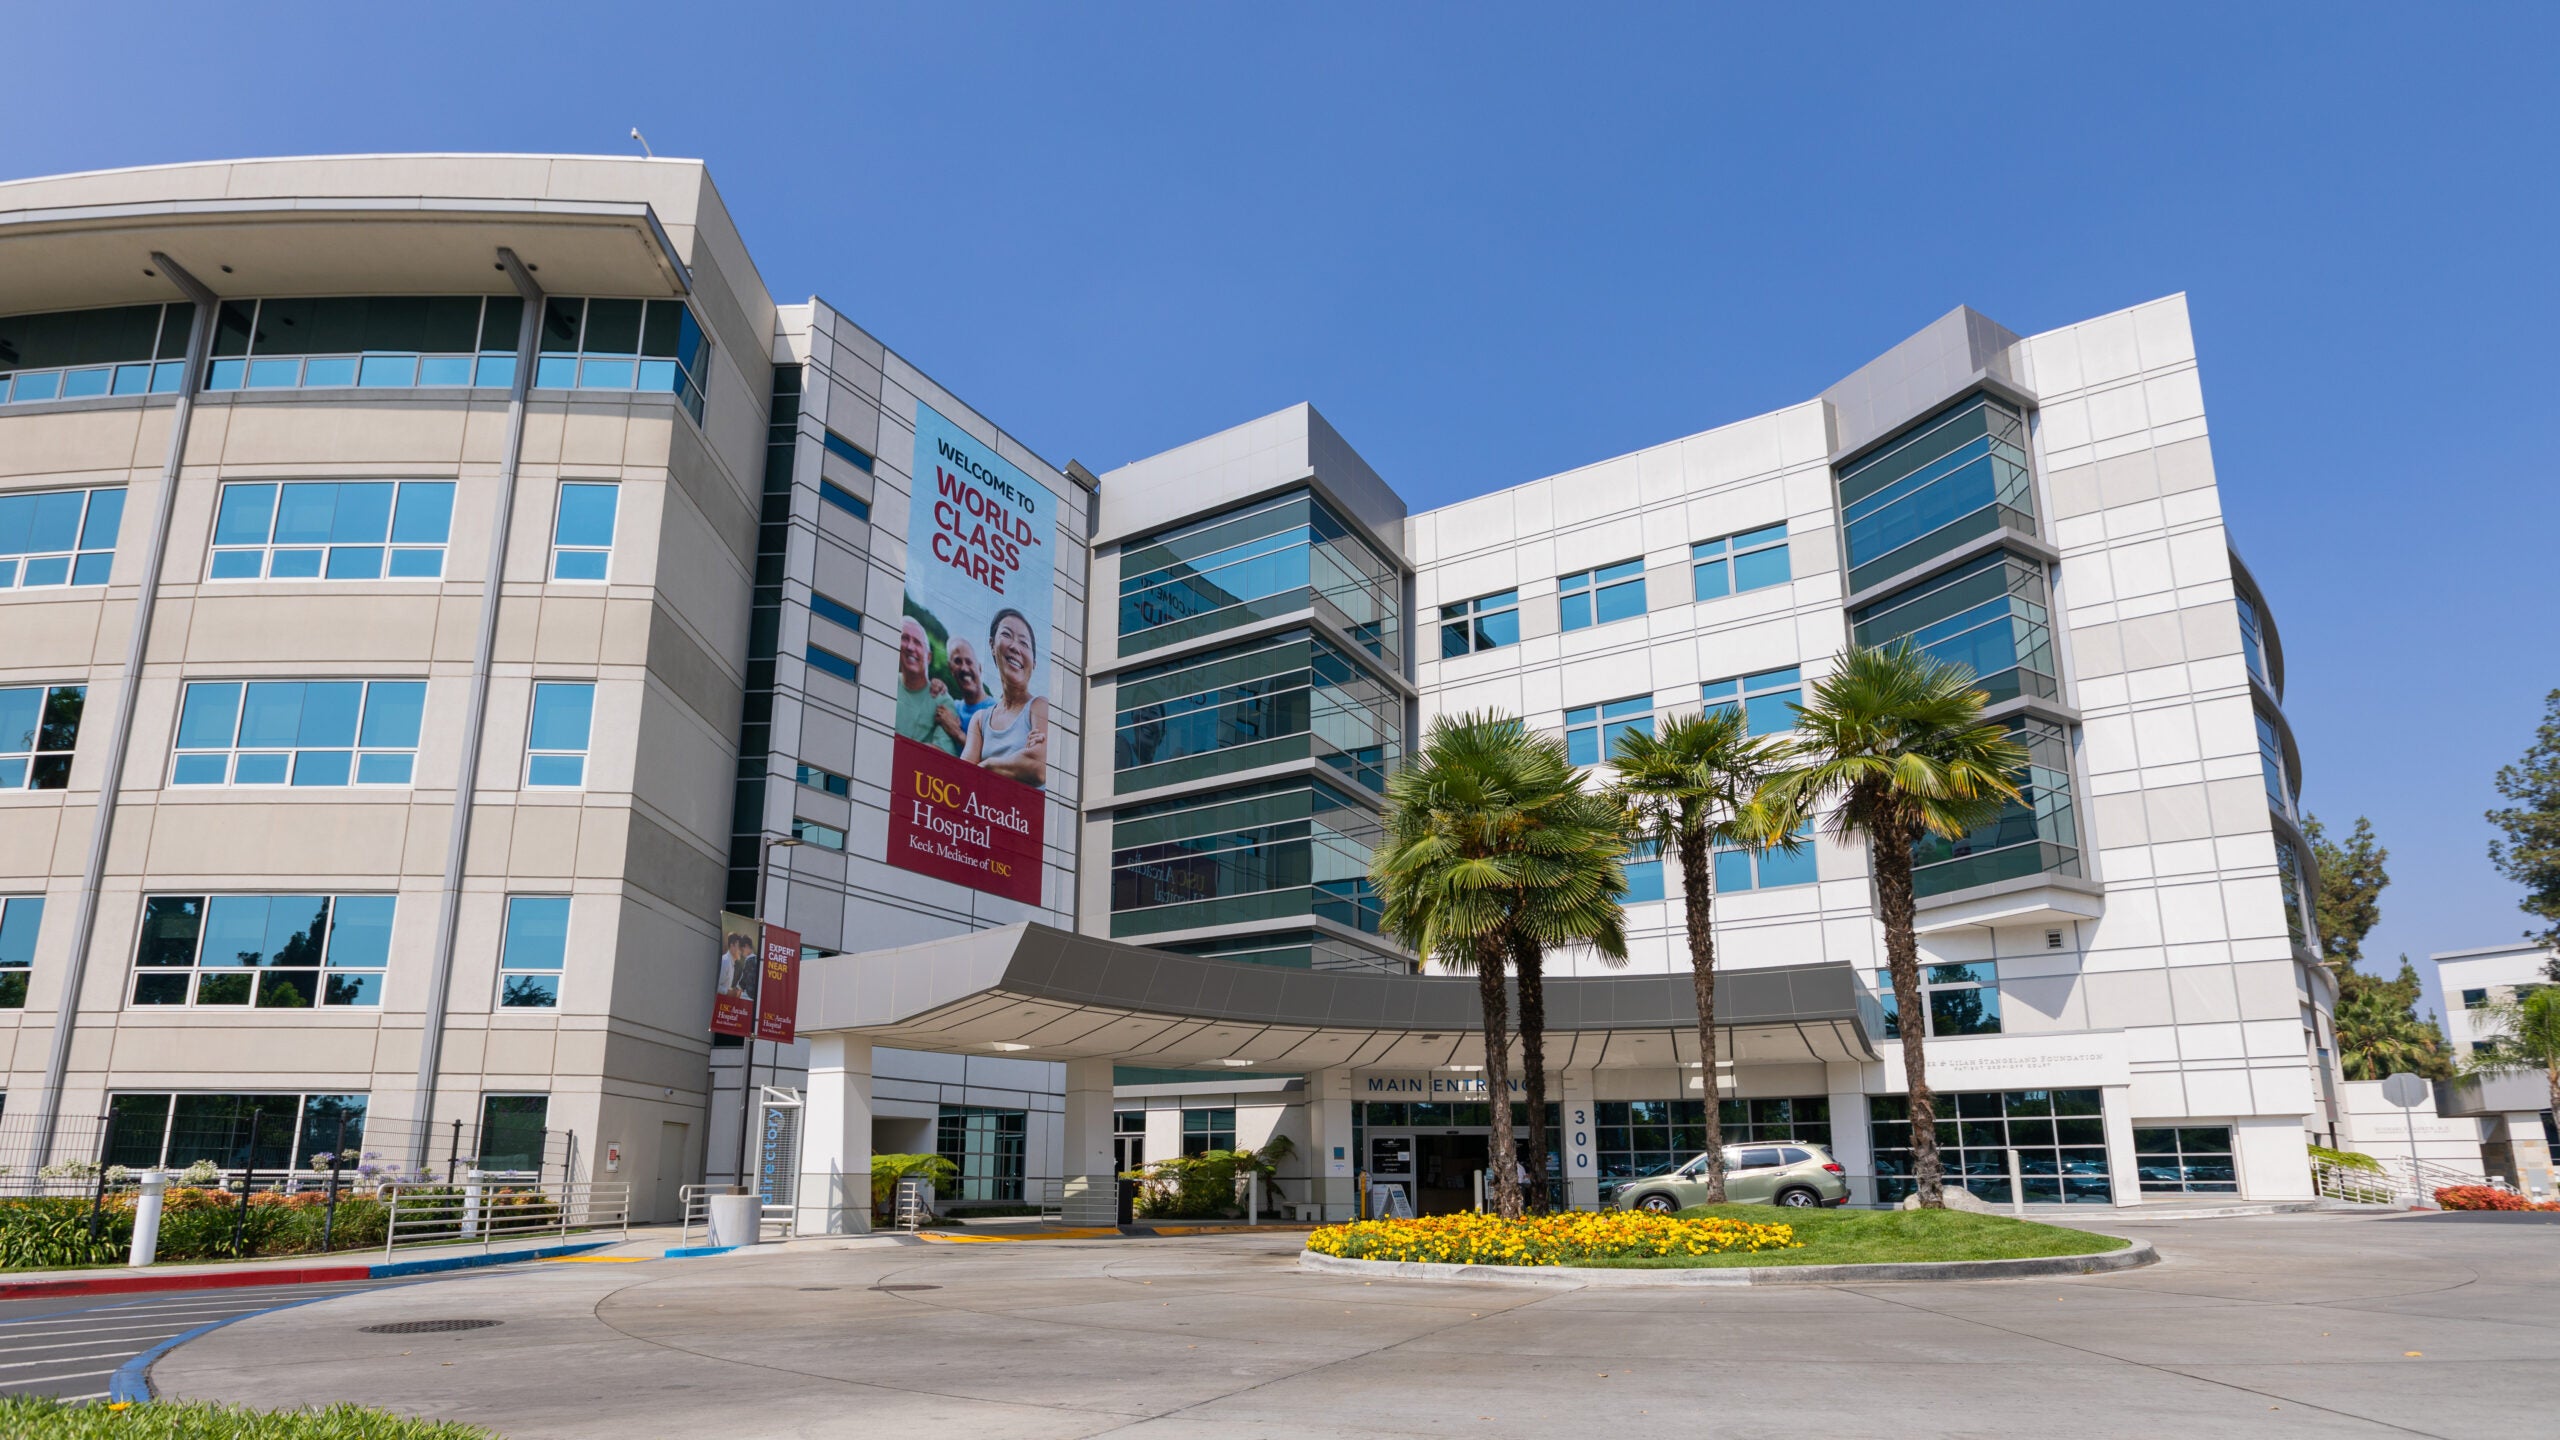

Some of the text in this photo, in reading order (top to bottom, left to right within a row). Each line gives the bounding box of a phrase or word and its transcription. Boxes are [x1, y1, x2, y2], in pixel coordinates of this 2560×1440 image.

[938, 437, 1035, 514] WELCOME TO
[936, 465, 1041, 547] WORLD-
[934, 500, 1021, 571] CLASS
[932, 533, 1005, 595] CARE
[911, 800, 991, 849] Hospital
[913, 770, 1030, 835] USC Arcadia
[909, 834, 1012, 878] Keck Medicine of USC
[767, 969, 783, 980] YOU
[768, 952, 788, 964] CARE
[768, 961, 788, 973] NEAR
[769, 943, 795, 957] EXPERT
[1368, 1078, 1423, 1092] MAIN
[760, 1108, 784, 1204] directory
[1575, 1110, 1588, 1168] 300
